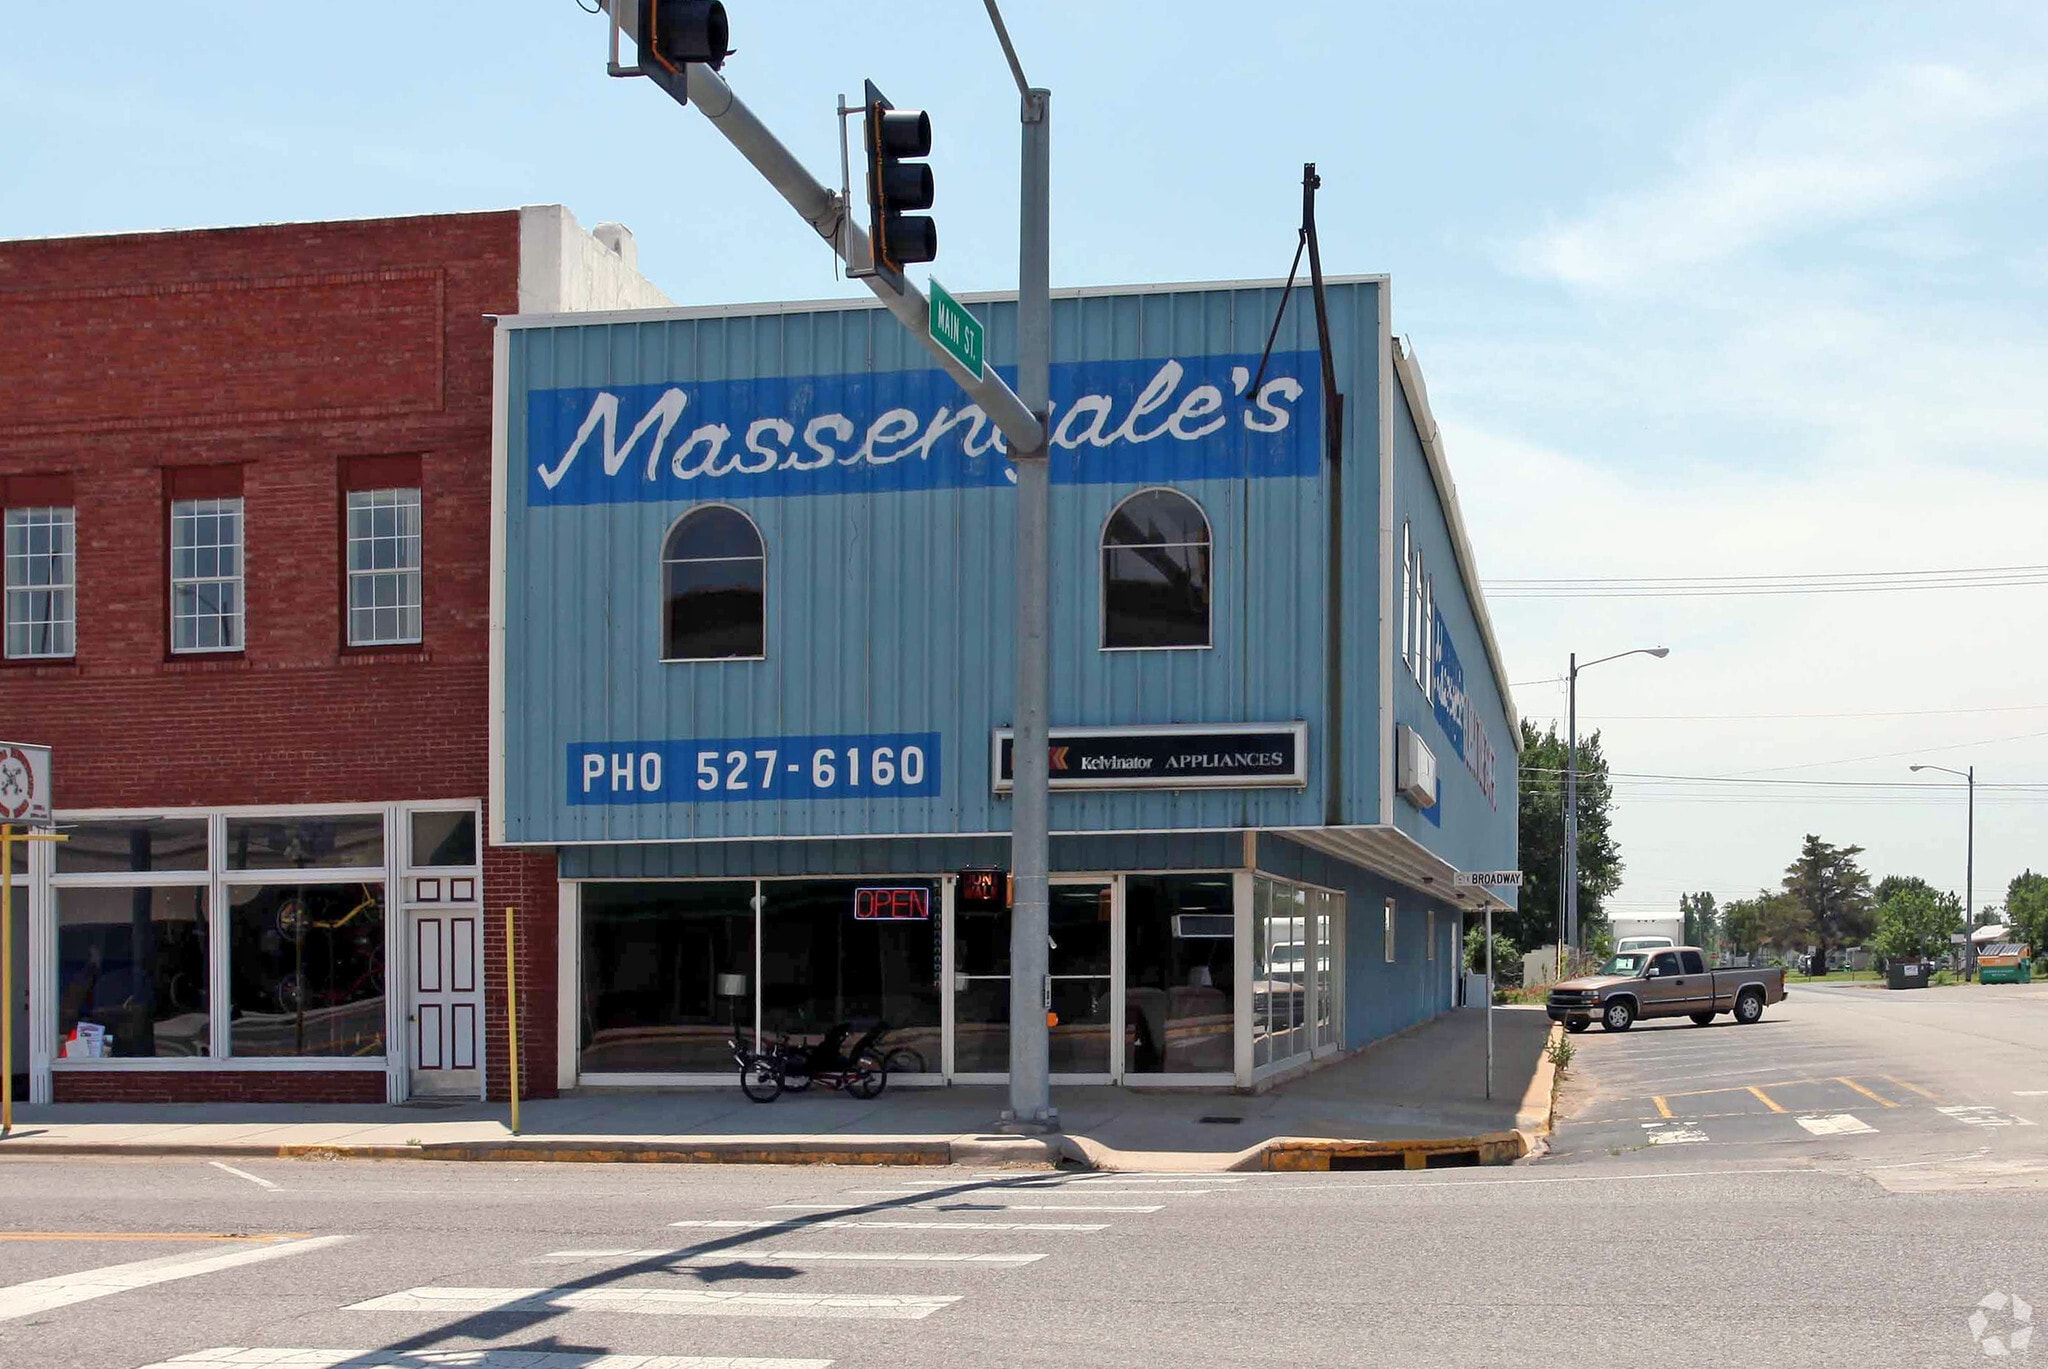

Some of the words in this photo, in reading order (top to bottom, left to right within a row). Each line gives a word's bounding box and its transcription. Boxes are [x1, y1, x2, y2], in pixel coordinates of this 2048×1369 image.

[937, 300, 960, 346] MAIN
[964, 325, 976, 361] ST.
[583, 752, 662, 792] PHO
[697, 746, 924, 791] 527-6160
[1081, 755, 1153, 770] Kelvinator
[1165, 751, 1283, 768] APPLIANCES
[1471, 873, 1520, 885] BROADWAY
[857, 889, 927, 918] OPEN
